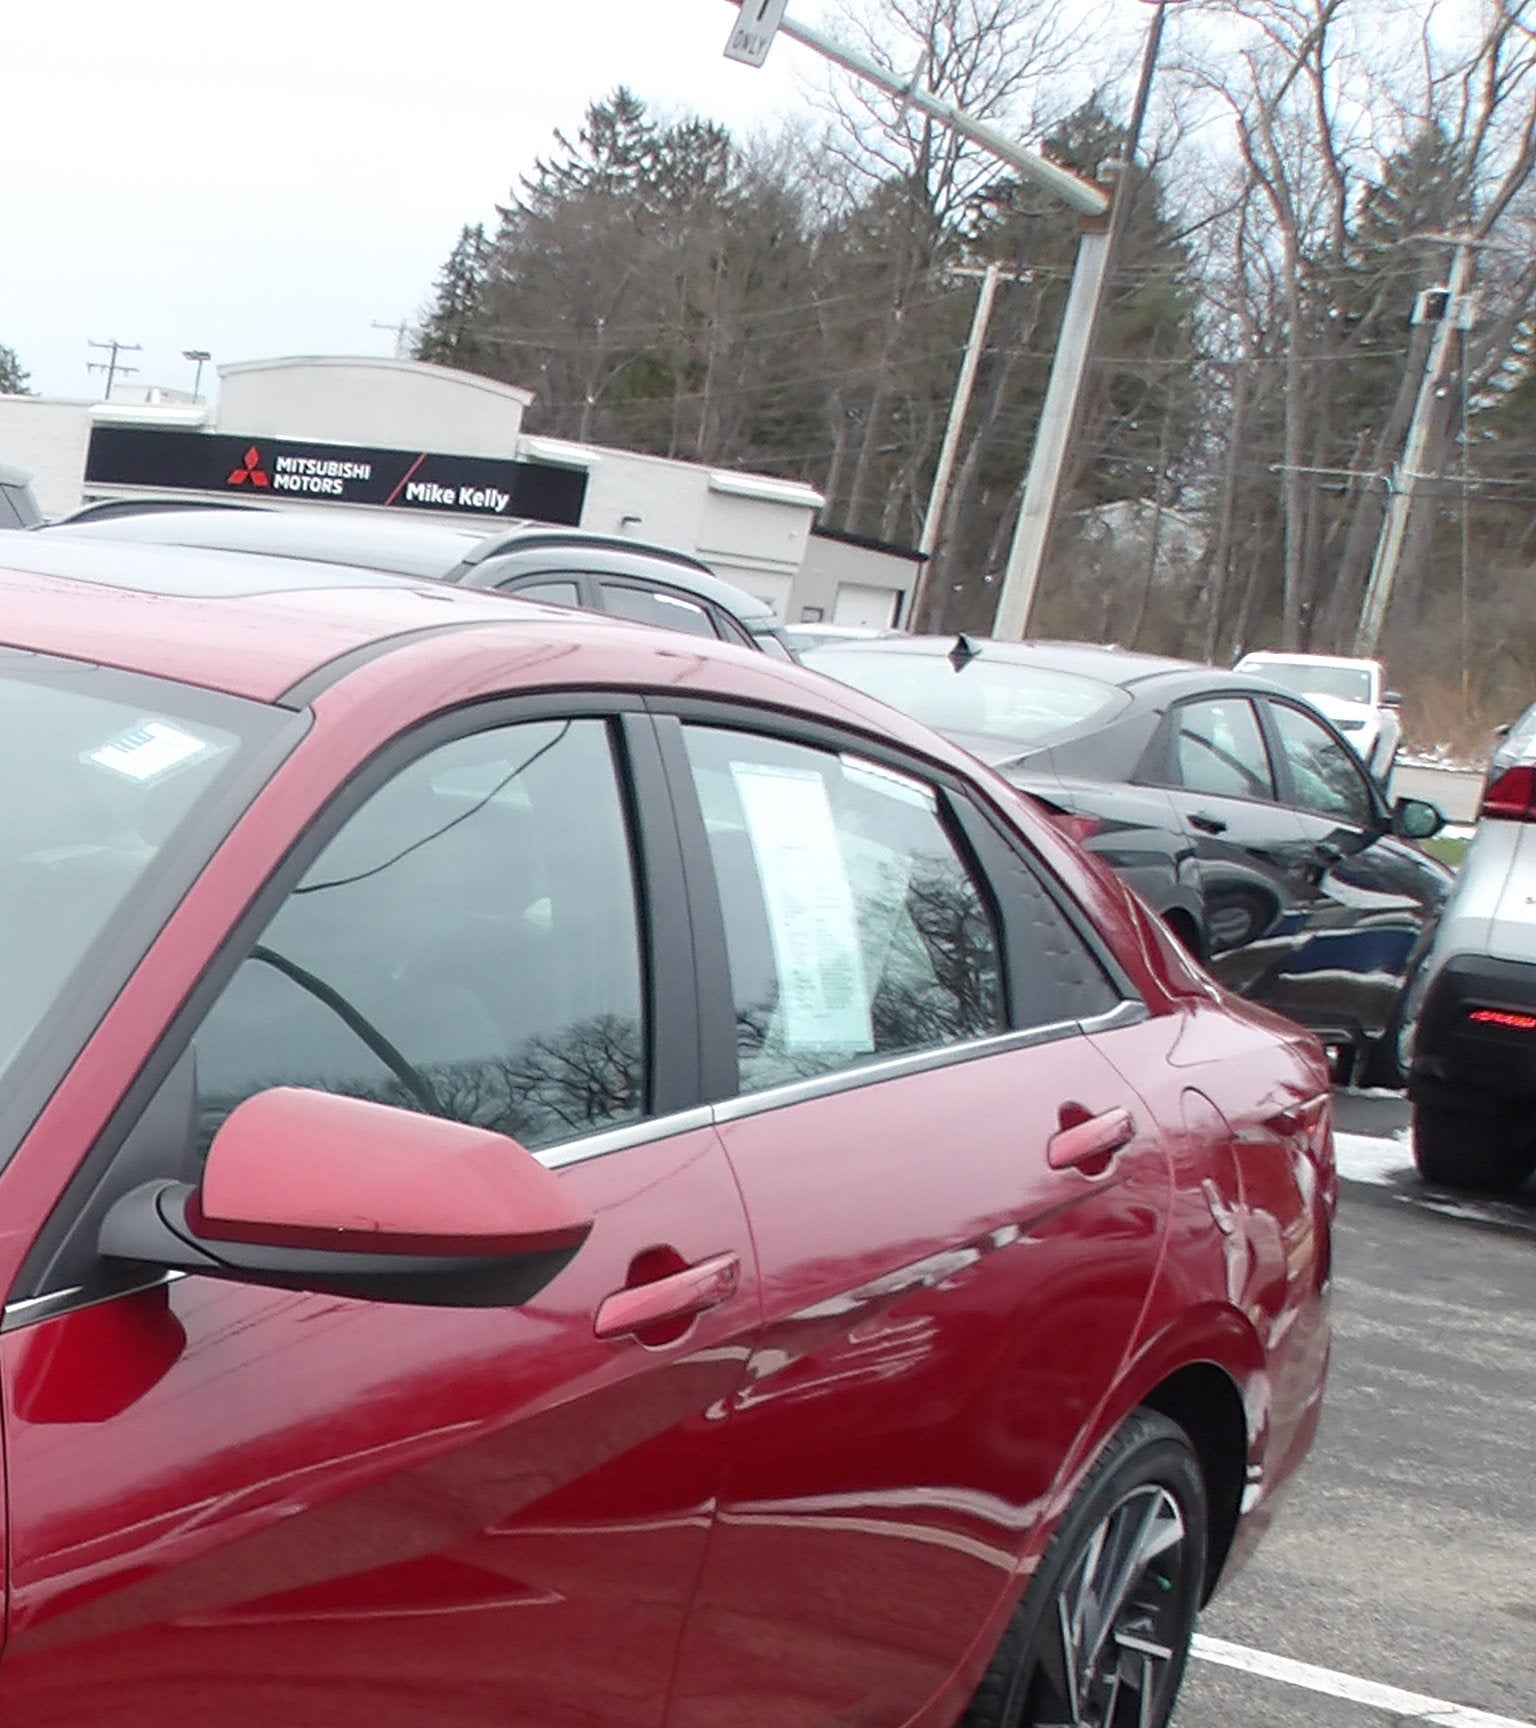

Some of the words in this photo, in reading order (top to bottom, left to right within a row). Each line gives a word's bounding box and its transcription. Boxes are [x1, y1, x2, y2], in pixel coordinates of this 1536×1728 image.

[732, 29, 767, 56] ONLY
[275, 456, 371, 479] MITSUBISHI
[273, 474, 343, 495] MOTORS
[406, 482, 455, 506] Mike
[458, 484, 510, 512] Kelly
